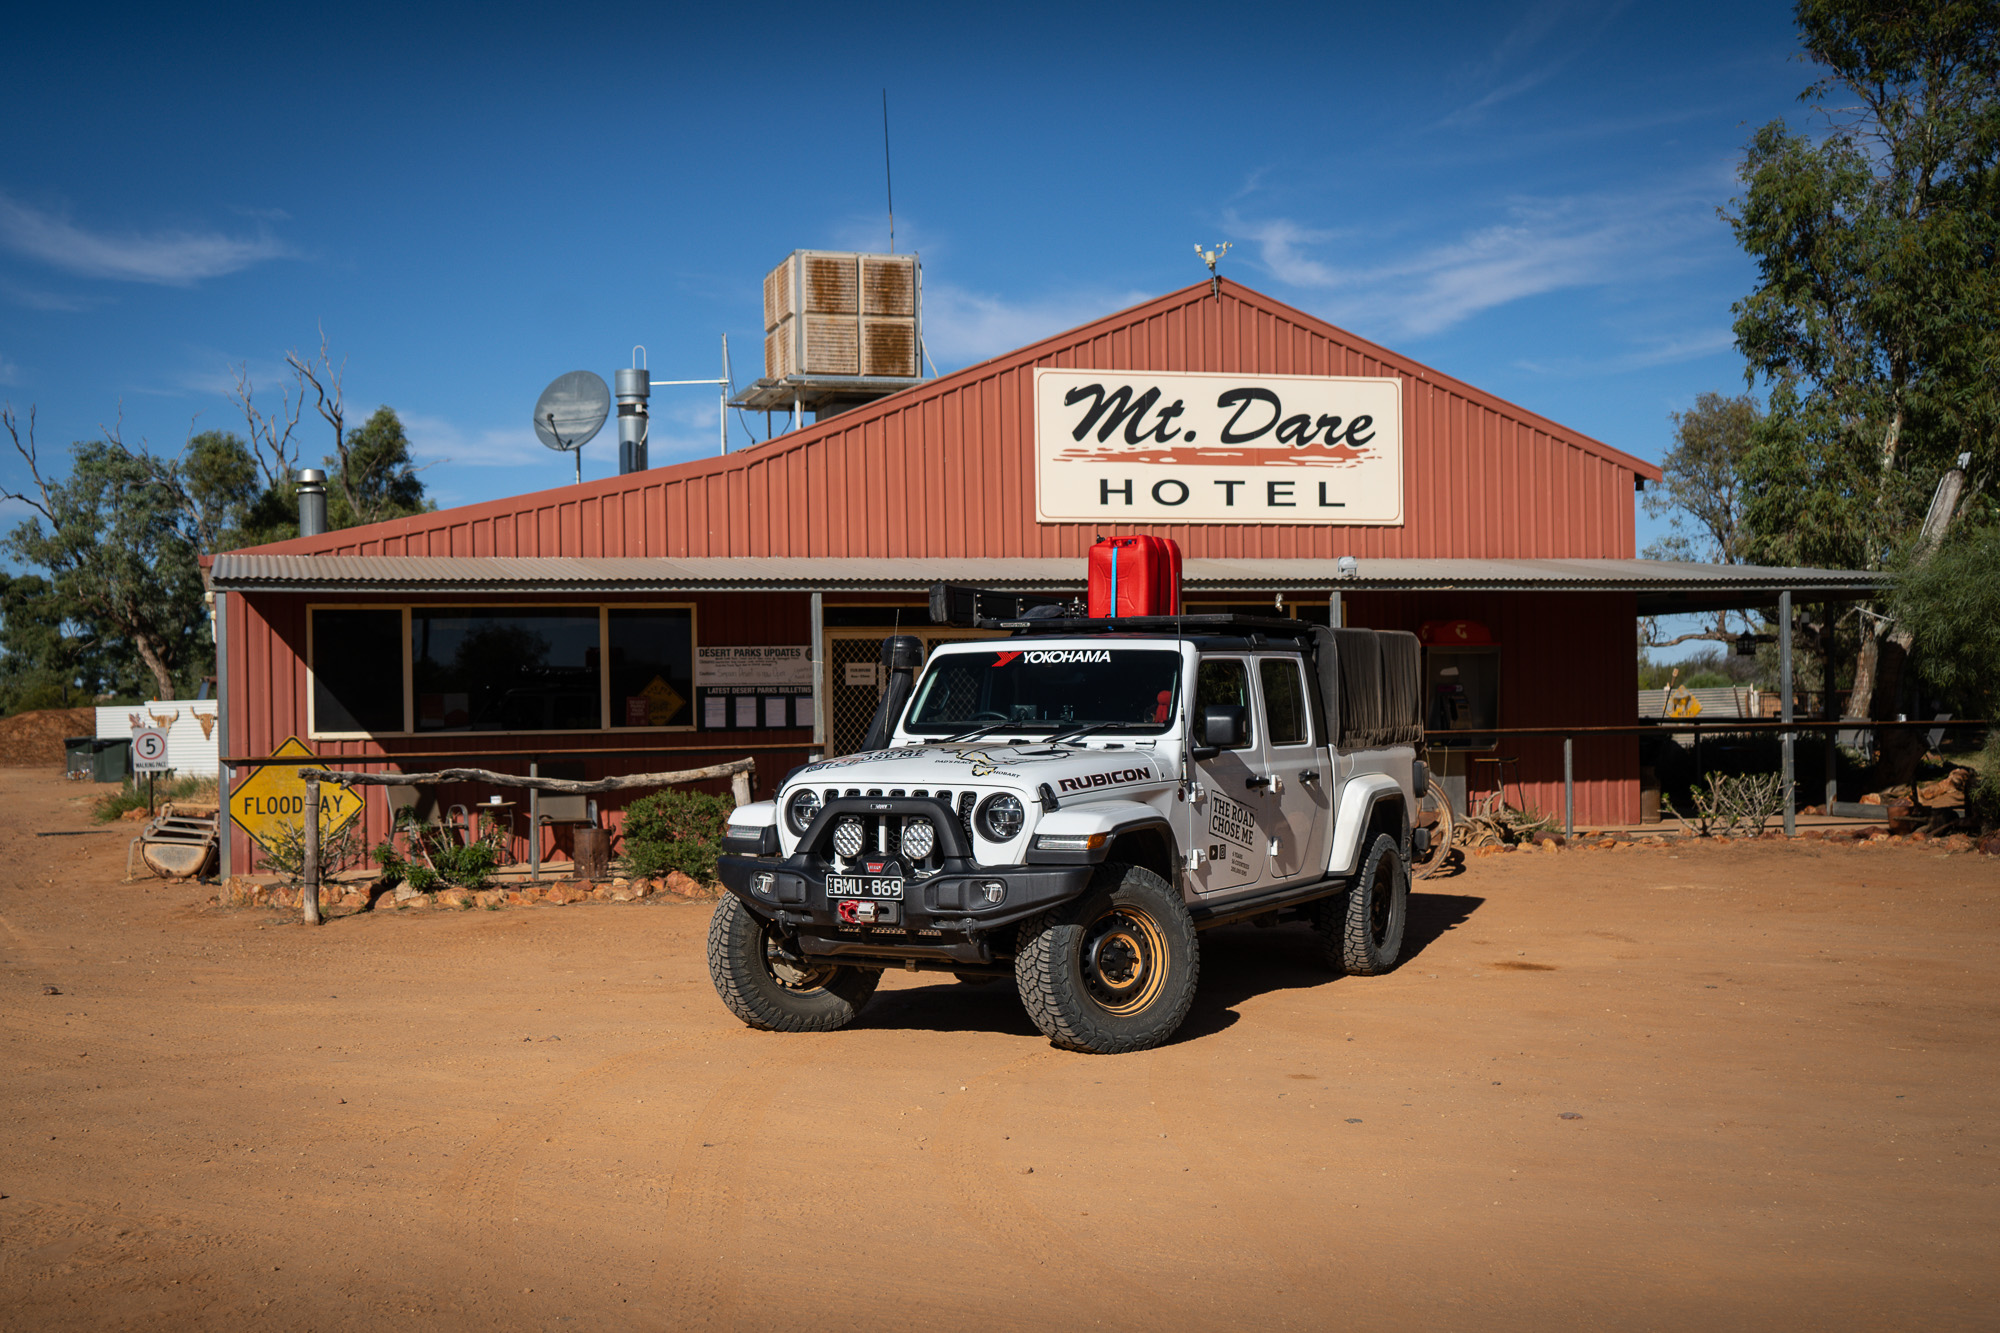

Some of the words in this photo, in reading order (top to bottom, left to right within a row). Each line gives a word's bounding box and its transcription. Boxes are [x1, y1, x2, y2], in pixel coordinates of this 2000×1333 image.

[1064, 383, 1197, 446] Mt.
[1217, 387, 1376, 447] Dare
[1099, 478, 1346, 508] HOTEL
[698, 648, 731, 658] DESERT
[734, 648, 761, 657] PARKS
[764, 648, 801, 657] UPDATES
[1023, 650, 1111, 664] YOKOHAMA
[778, 686, 812, 694] BULLETINS
[146, 738, 156, 755] 5
[993, 770, 1021, 778] HOBART
[1058, 767, 1151, 793] RUBICON
[244, 795, 343, 815] FLOODAY
[1213, 797, 1230, 818] THE
[1231, 805, 1255, 828] ROAD
[1212, 815, 1240, 840] CHOSE
[1241, 827, 1254, 846] ME
